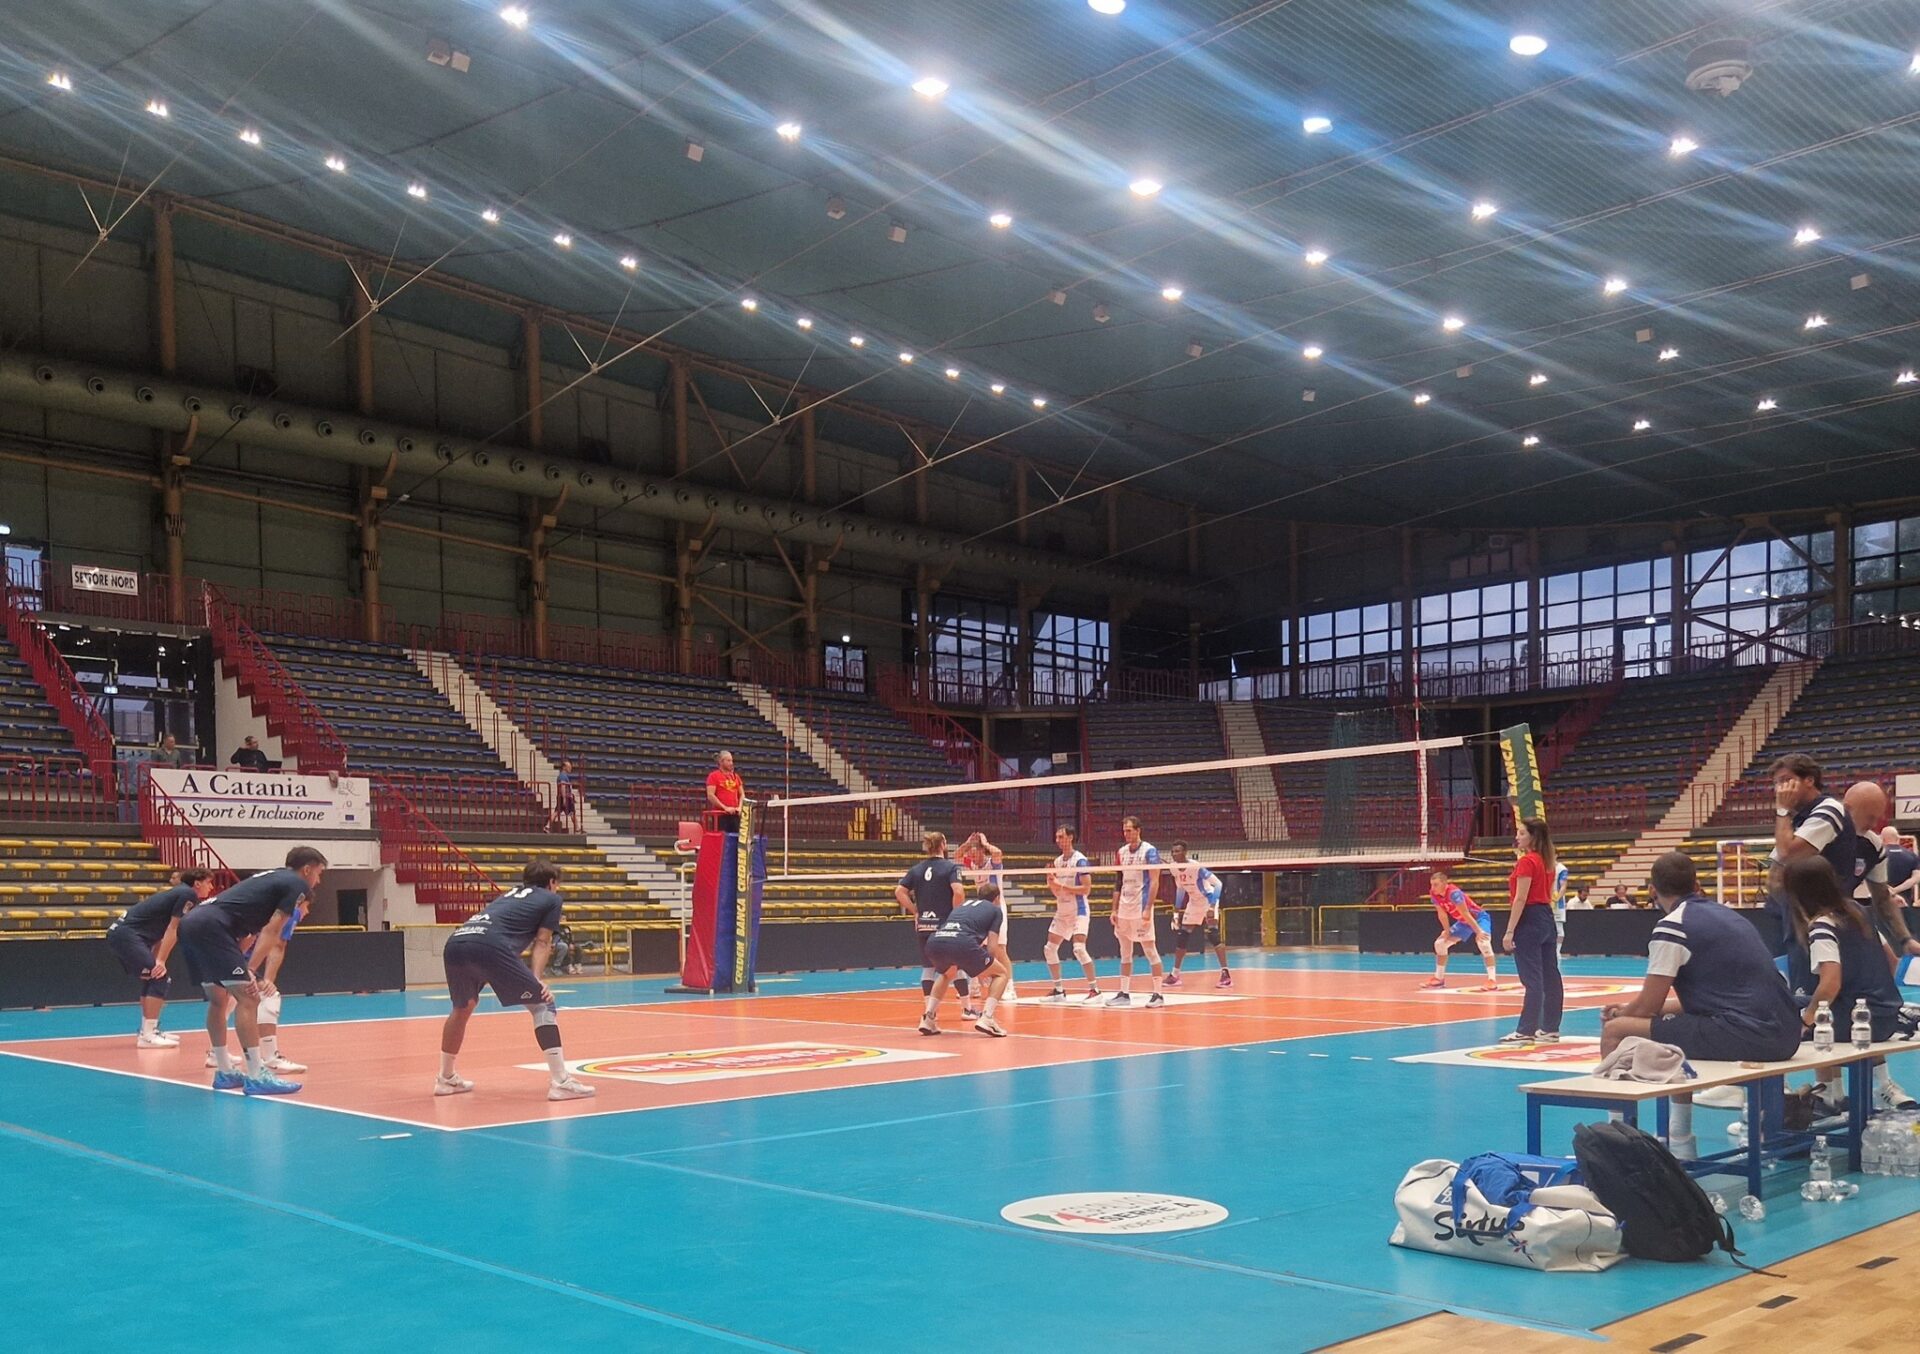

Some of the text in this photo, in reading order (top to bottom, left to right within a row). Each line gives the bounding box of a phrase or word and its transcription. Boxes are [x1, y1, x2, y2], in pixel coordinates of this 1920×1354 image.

[112, 575, 136, 589] NORD
[180, 773, 308, 798] A Catania
[189, 803, 234, 823] Sport
[238, 804, 246, 819] è
[250, 805, 325, 821] Inclusione
[924, 866, 933, 881] 6
[735, 805, 750, 985] CREDEM BANCA CREDEM BANCA
